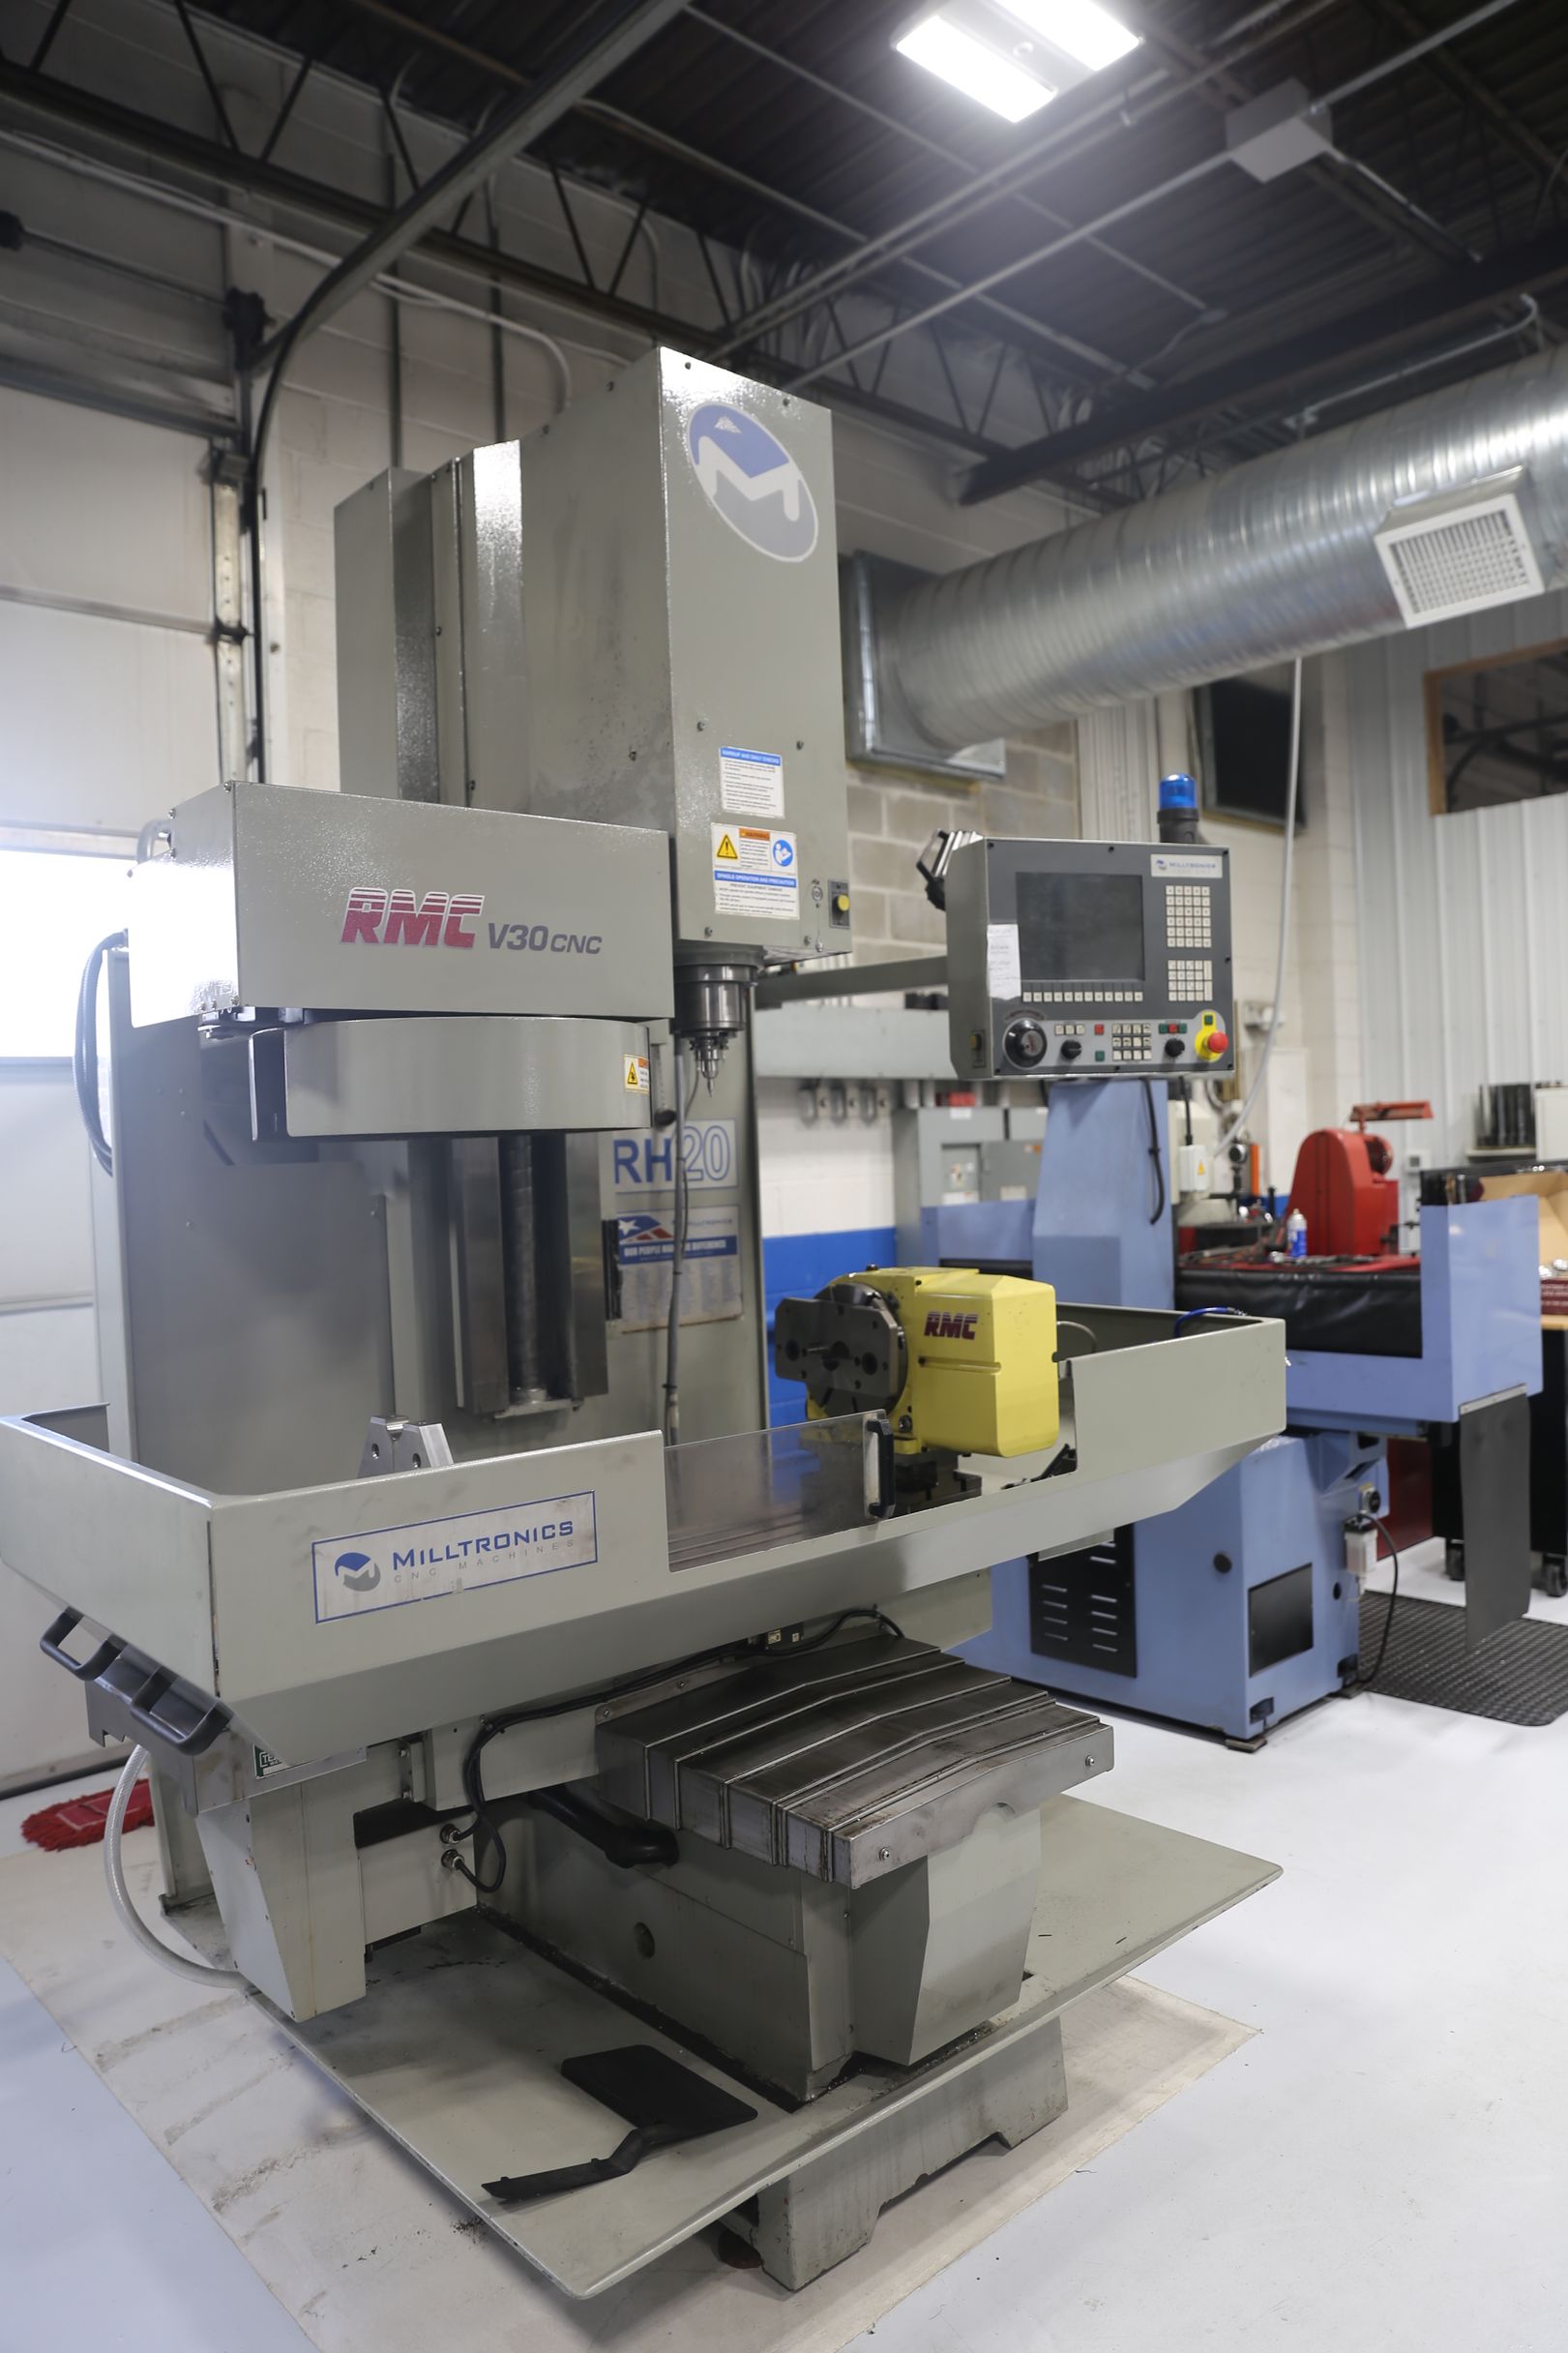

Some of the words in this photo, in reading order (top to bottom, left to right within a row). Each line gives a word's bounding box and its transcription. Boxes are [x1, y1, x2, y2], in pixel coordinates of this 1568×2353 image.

[340, 886, 486, 949] RMC
[488, 922, 548, 952] V30
[550, 934, 603, 955] CNC
[924, 1310, 979, 1341] RMC
[392, 1520, 575, 1571] MILLTRONICS
[394, 1566, 438, 1584] CNC
[459, 1538, 575, 1571] MACHINES
